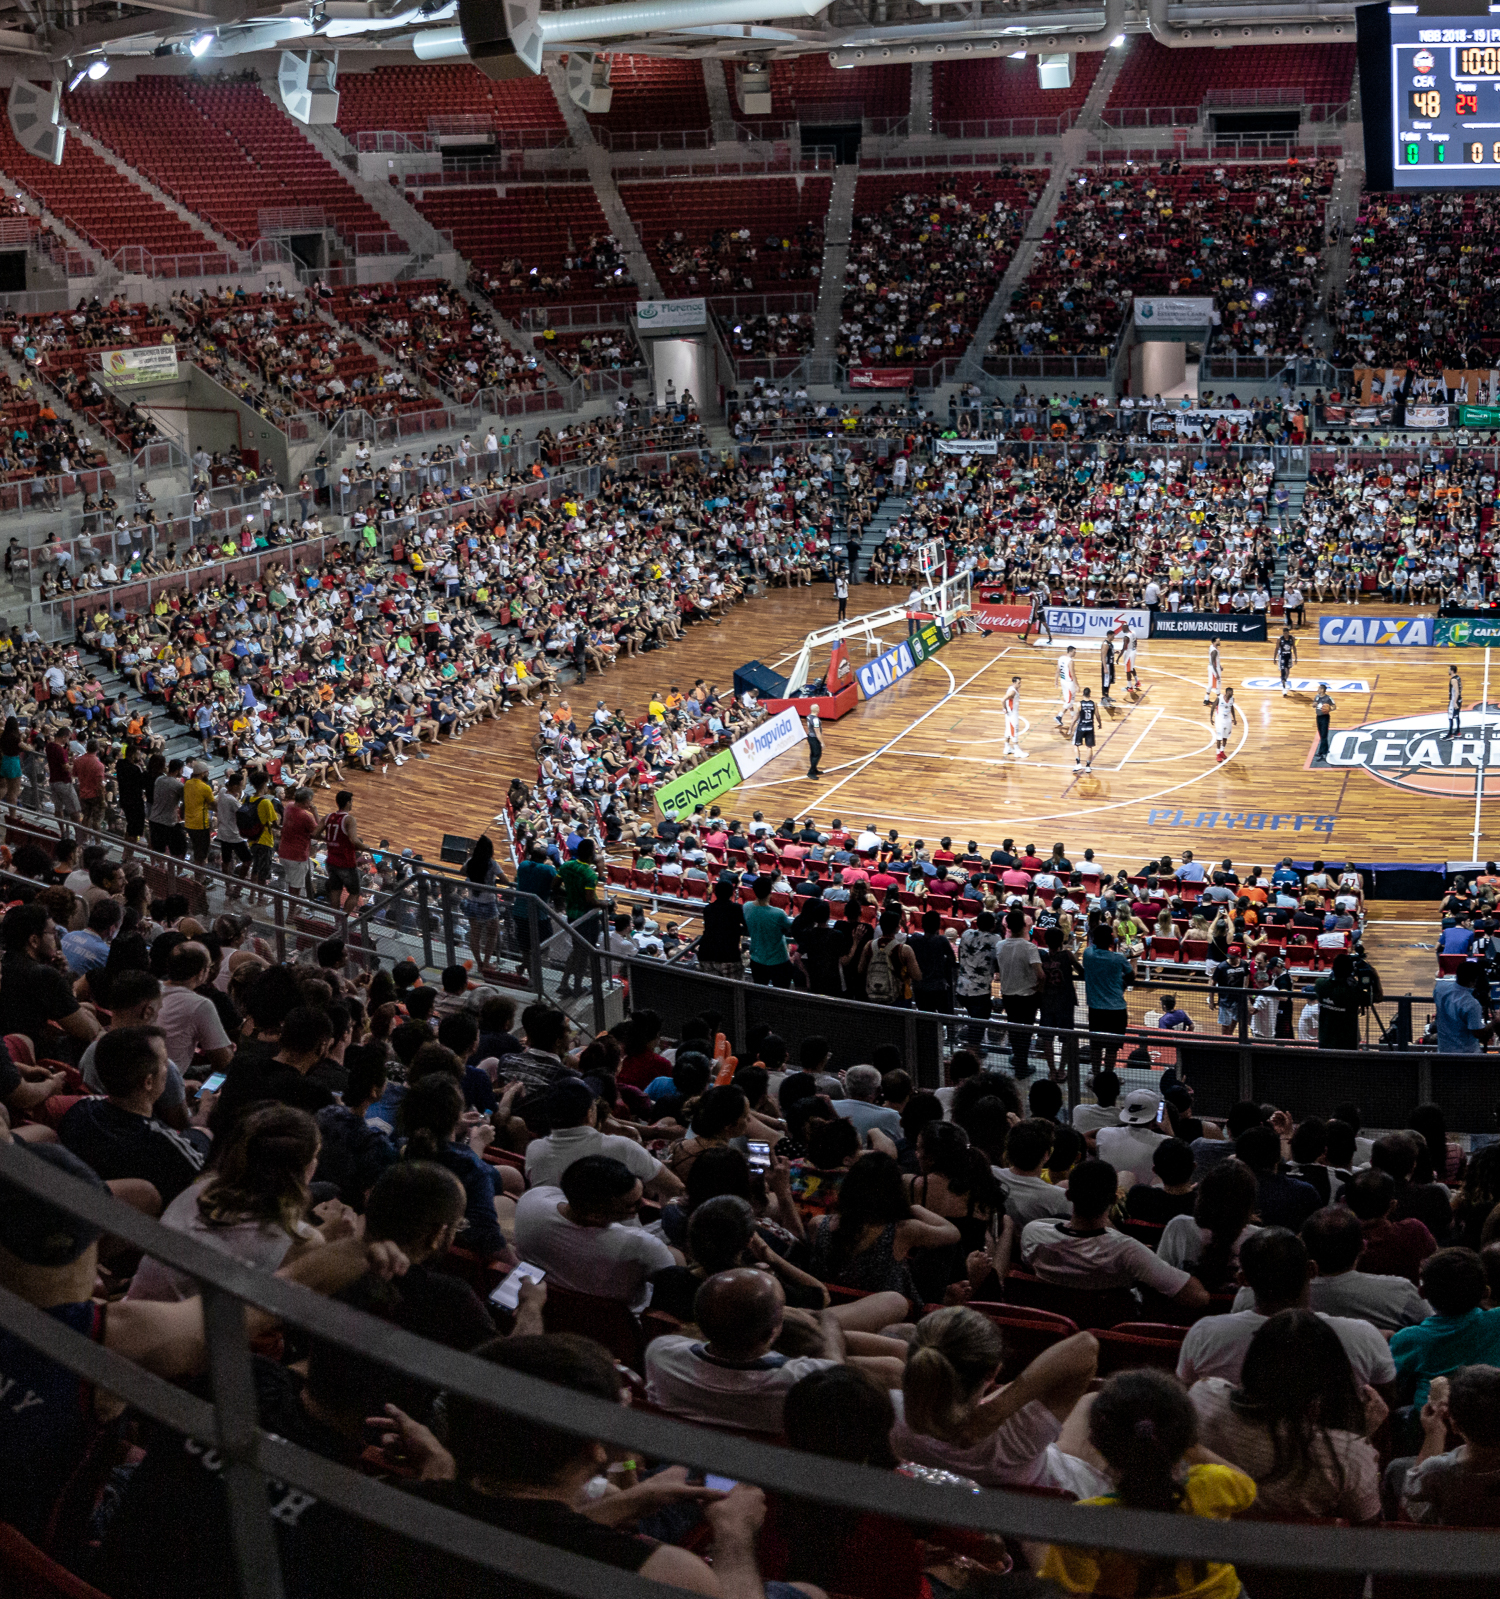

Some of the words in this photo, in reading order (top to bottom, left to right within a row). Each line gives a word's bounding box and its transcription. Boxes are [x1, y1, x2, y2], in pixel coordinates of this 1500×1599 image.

[1419, 29, 1441, 43] NBB
[1442, 29, 1467, 43] 2018
[1473, 29, 1486, 42] 19
[1412, 75, 1436, 88] CEA
[1413, 90, 1441, 118] 48
[1455, 94, 1478, 115] 24
[1407, 143, 1419, 164] 0
[1438, 144, 1445, 163] 1
[1471, 142, 1484, 164] 0
[661, 303, 703, 313] Florence
[978, 610, 1028, 628] weiser
[1048, 611, 1085, 628] EAD
[1157, 620, 1238, 634] NIKE.COM/BASQUETE
[1322, 619, 1428, 645] CAIXA
[861, 644, 914, 696] CAIXA
[1247, 679, 1364, 691] CAIXA
[753, 718, 793, 753] hapvida
[662, 762, 731, 812] PENALTY
[1148, 809, 1338, 833] PLAYOFFS
[327, 823, 339, 841] 17
